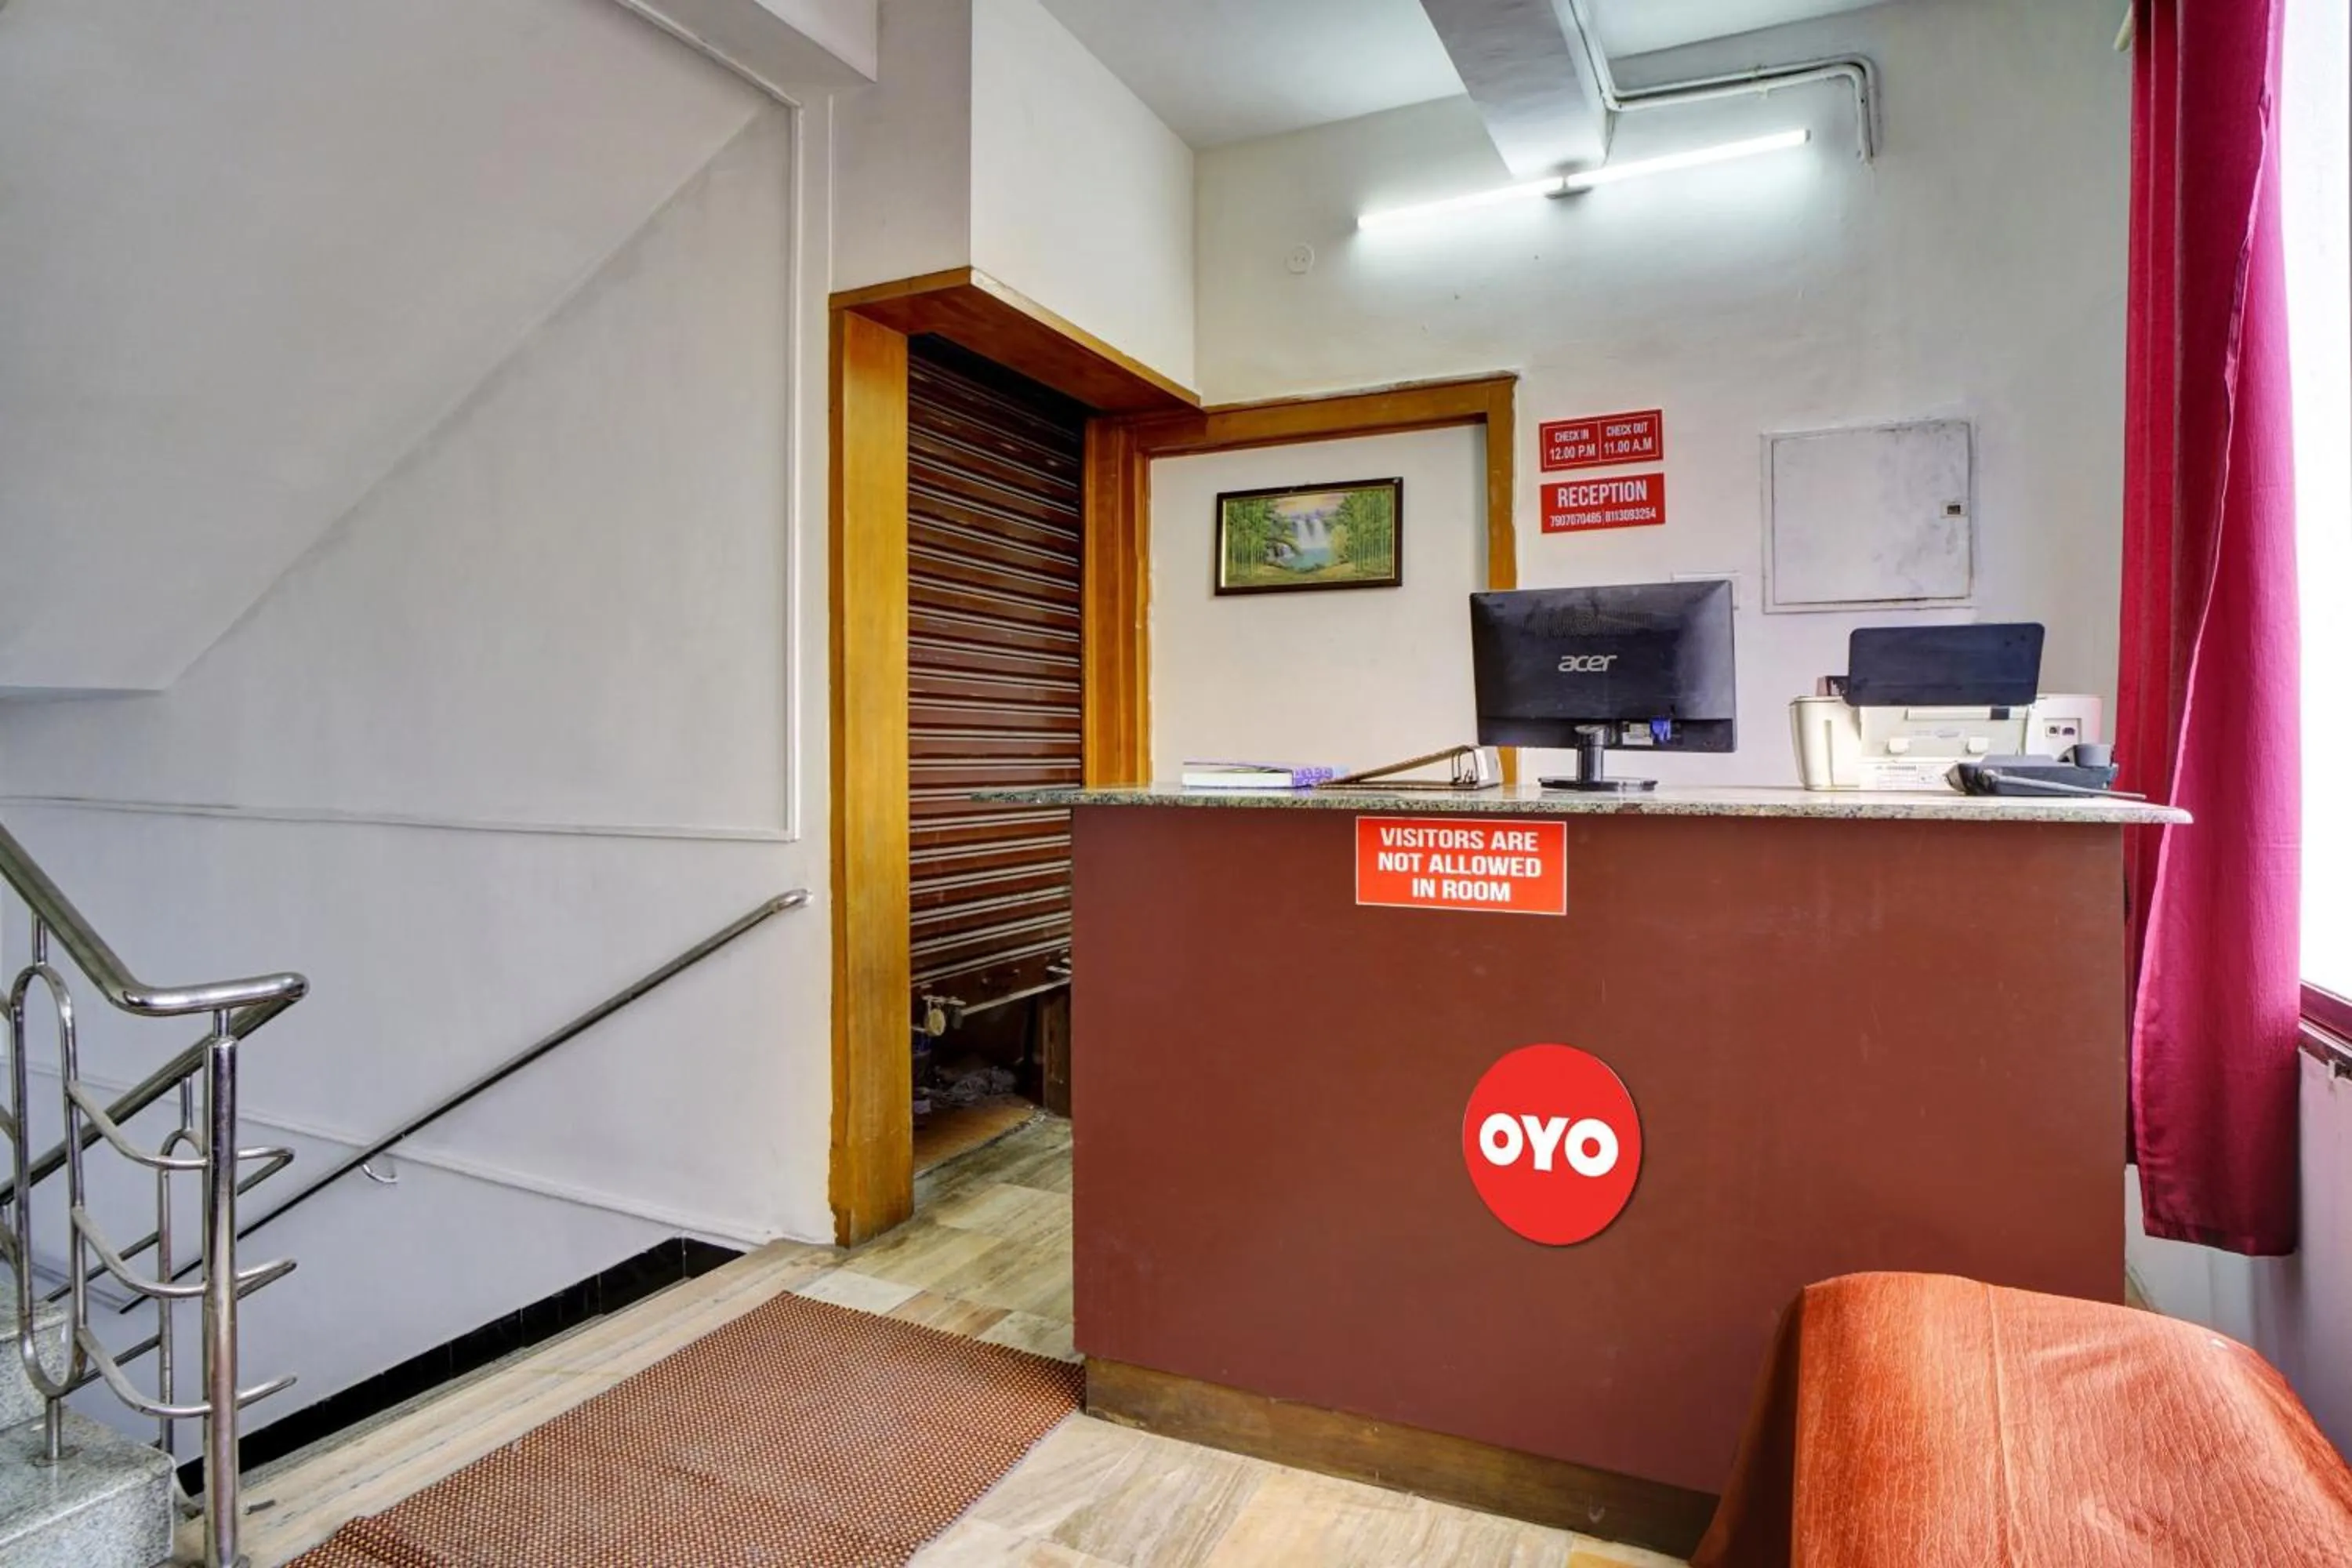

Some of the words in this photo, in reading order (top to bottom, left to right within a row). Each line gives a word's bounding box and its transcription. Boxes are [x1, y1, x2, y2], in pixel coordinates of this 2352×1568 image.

[1555, 430, 1580, 443] CHECK
[1581, 429, 1589, 441] IN
[1606, 424, 1632, 437] CHECK
[1633, 421, 1649, 434] OUT
[1549, 446, 1575, 461] 12.00
[1604, 441, 1630, 455] 11.00
[1632, 437, 1653, 452] A.M
[1557, 480, 1647, 508] RECEPTION
[1558, 654, 1617, 673] acer
[1380, 827, 1485, 850] VISITORS
[1490, 831, 1539, 851] ARE
[1377, 852, 1423, 873] NOT
[1428, 855, 1541, 878] ALLOWED
[1412, 877, 1436, 898] IN
[1442, 880, 1511, 902] ROOM
[1479, 1112, 1619, 1178] OYO
